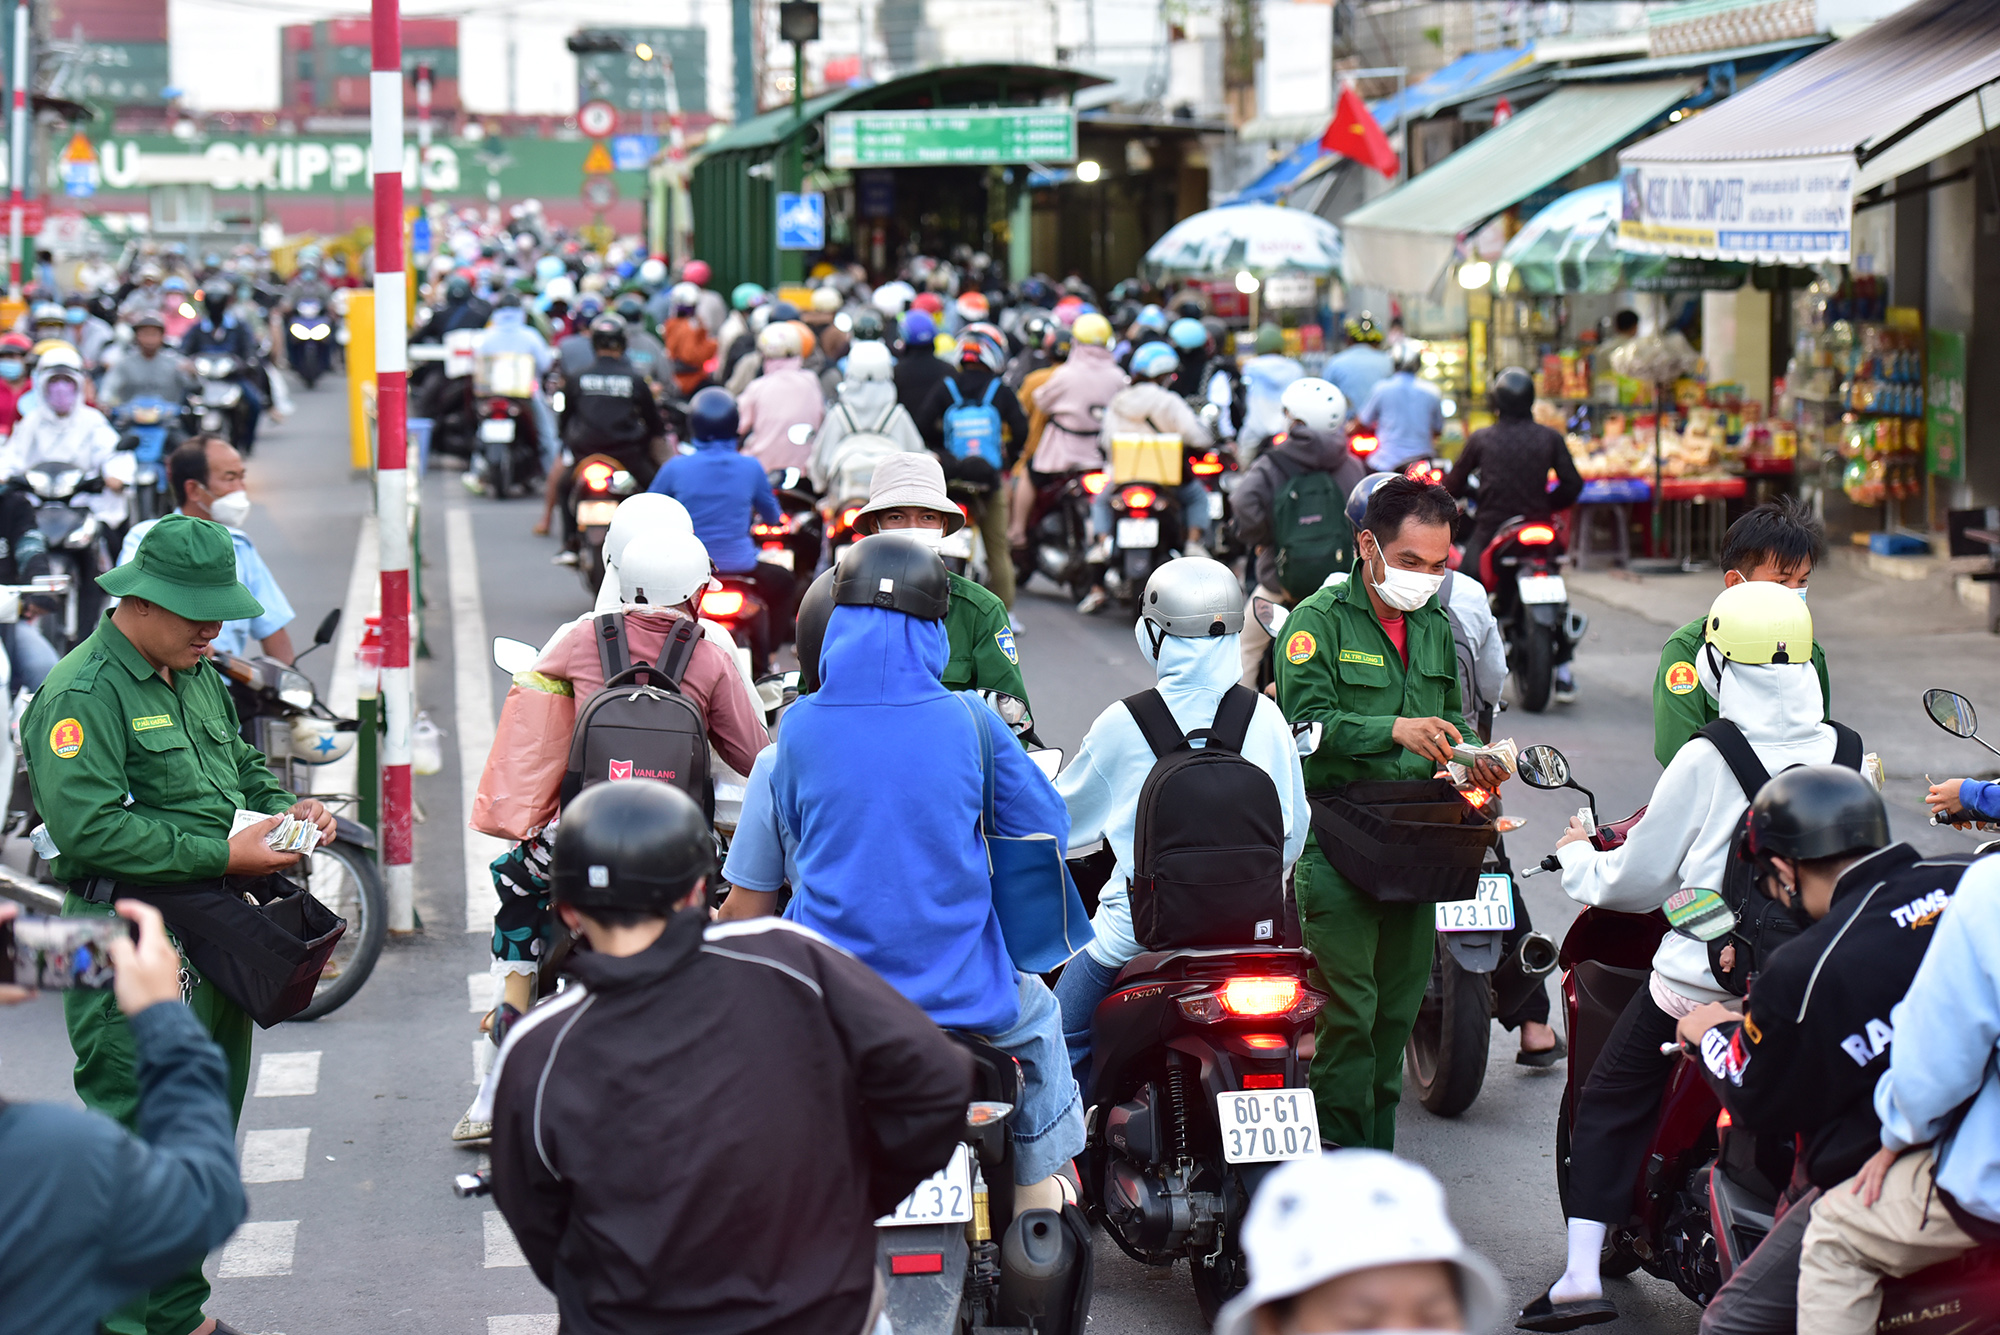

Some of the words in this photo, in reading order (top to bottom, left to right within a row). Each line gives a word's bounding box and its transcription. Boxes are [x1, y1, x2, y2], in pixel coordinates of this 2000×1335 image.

[1291, 653, 1310, 661] TNXP
[57, 745, 79, 754] TNXP
[634, 768, 676, 779] VANLANG
[1440, 904, 1508, 927] 123.10
[1890, 888, 1949, 928] TUMS
[1124, 986, 1165, 1002] VISION
[1234, 1095, 1299, 1125] 60-G1
[1229, 1126, 1314, 1157] 370.02
[891, 1186, 964, 1218] 2.32
